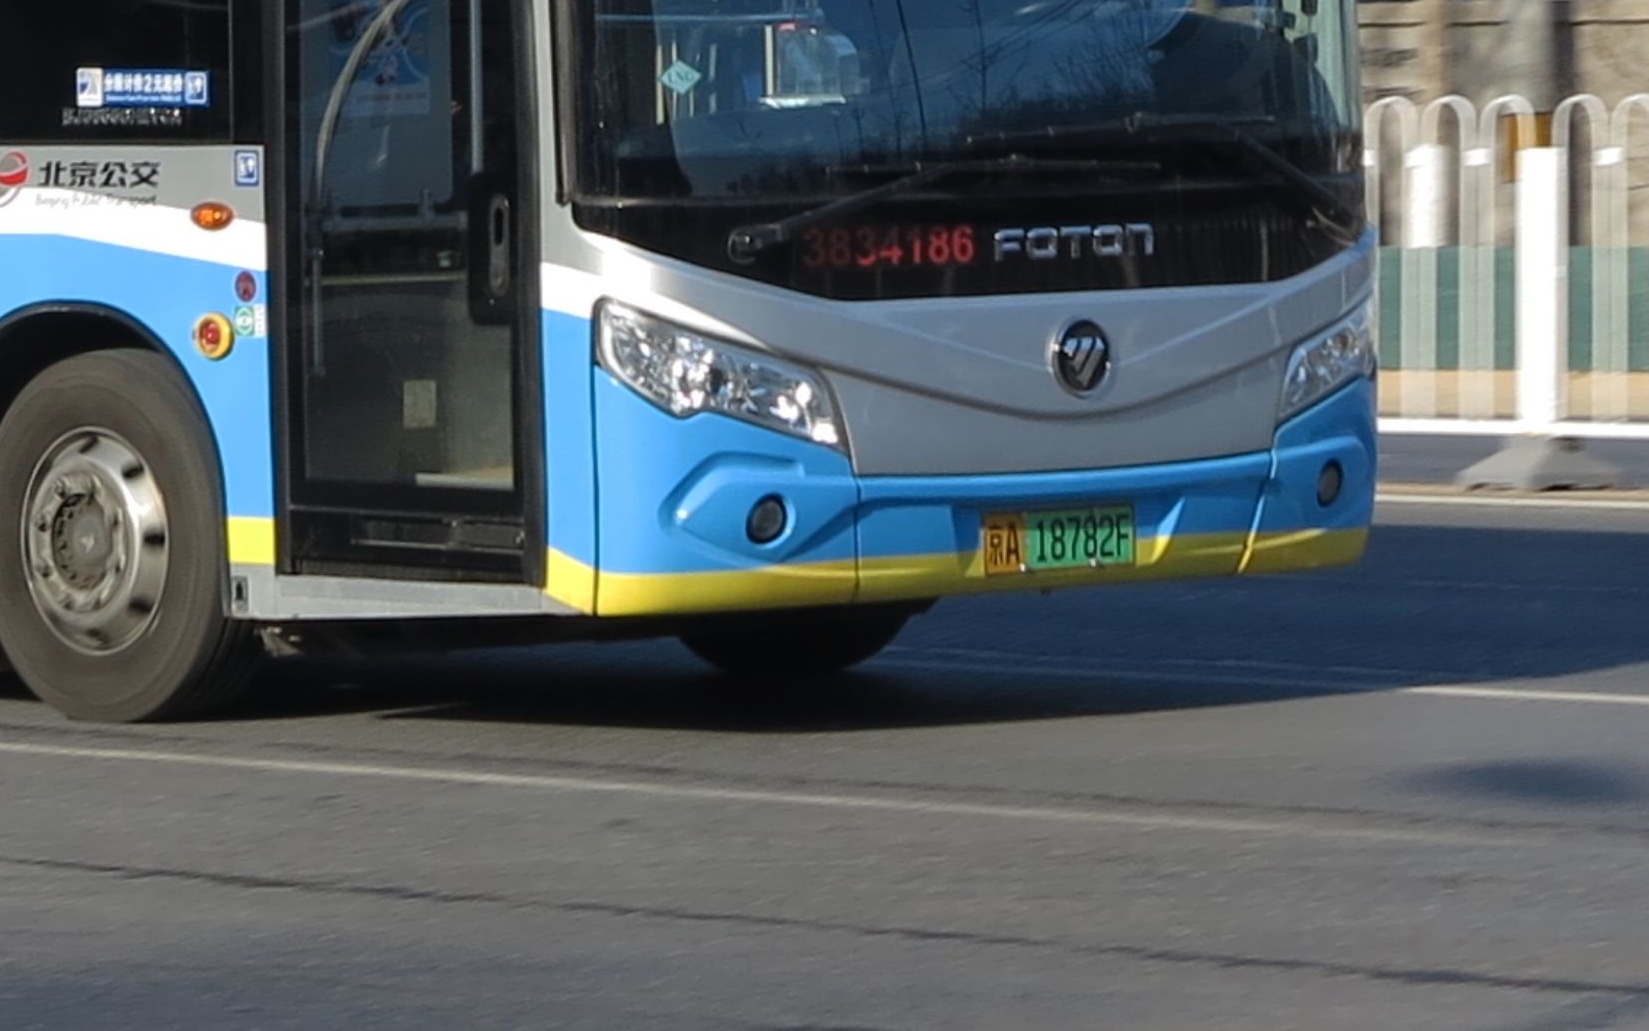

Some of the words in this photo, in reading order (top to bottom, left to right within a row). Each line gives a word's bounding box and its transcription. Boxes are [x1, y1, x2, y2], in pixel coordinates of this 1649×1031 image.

[38, 160, 161, 188] 北京公交
[803, 225, 976, 267] 3834186
[994, 223, 1154, 262] FOTON
[1037, 515, 1129, 563] 18782F
